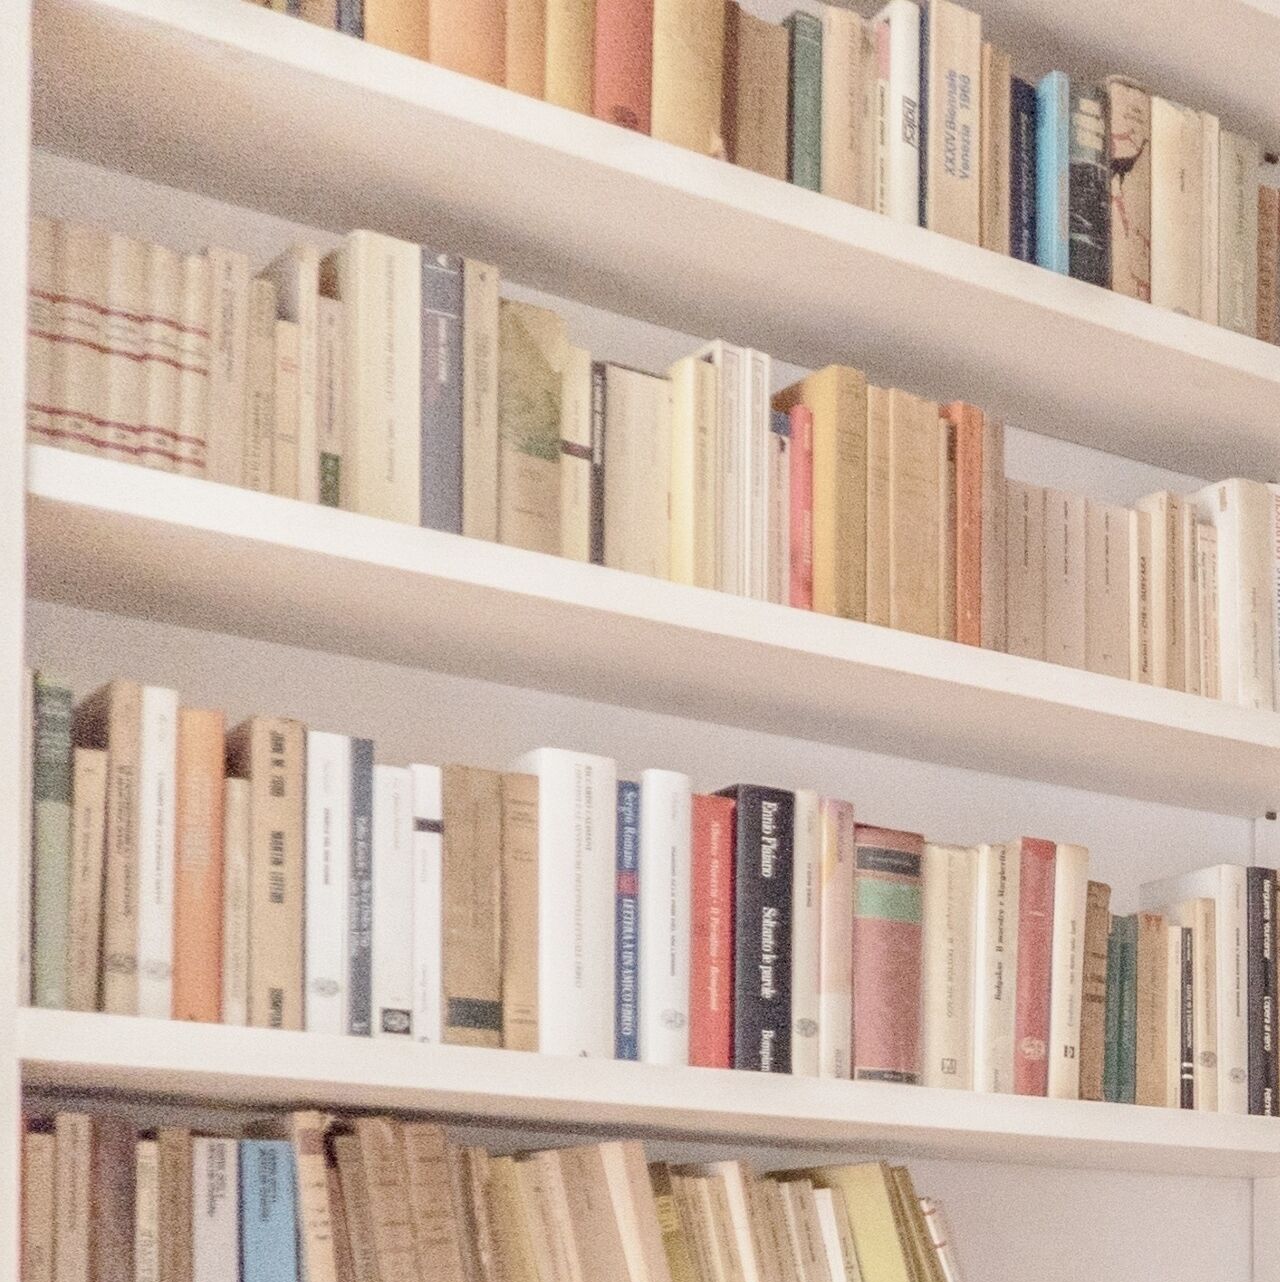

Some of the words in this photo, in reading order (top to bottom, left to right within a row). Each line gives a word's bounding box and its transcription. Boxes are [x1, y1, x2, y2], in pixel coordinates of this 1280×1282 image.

[942, 69, 959, 130] Biennale
[957, 124, 972, 181] Venezia
[619, 790, 637, 823] Sergio
[761, 800, 777, 835] Ennio
[622, 827, 636, 869] Romano
[761, 836, 777, 878] Flaiano
[622, 898, 635, 934] LETTERA
[761, 906, 777, 952] Soltanto
[622, 960, 635, 1001] AMICO
[758, 966, 776, 999] parole
